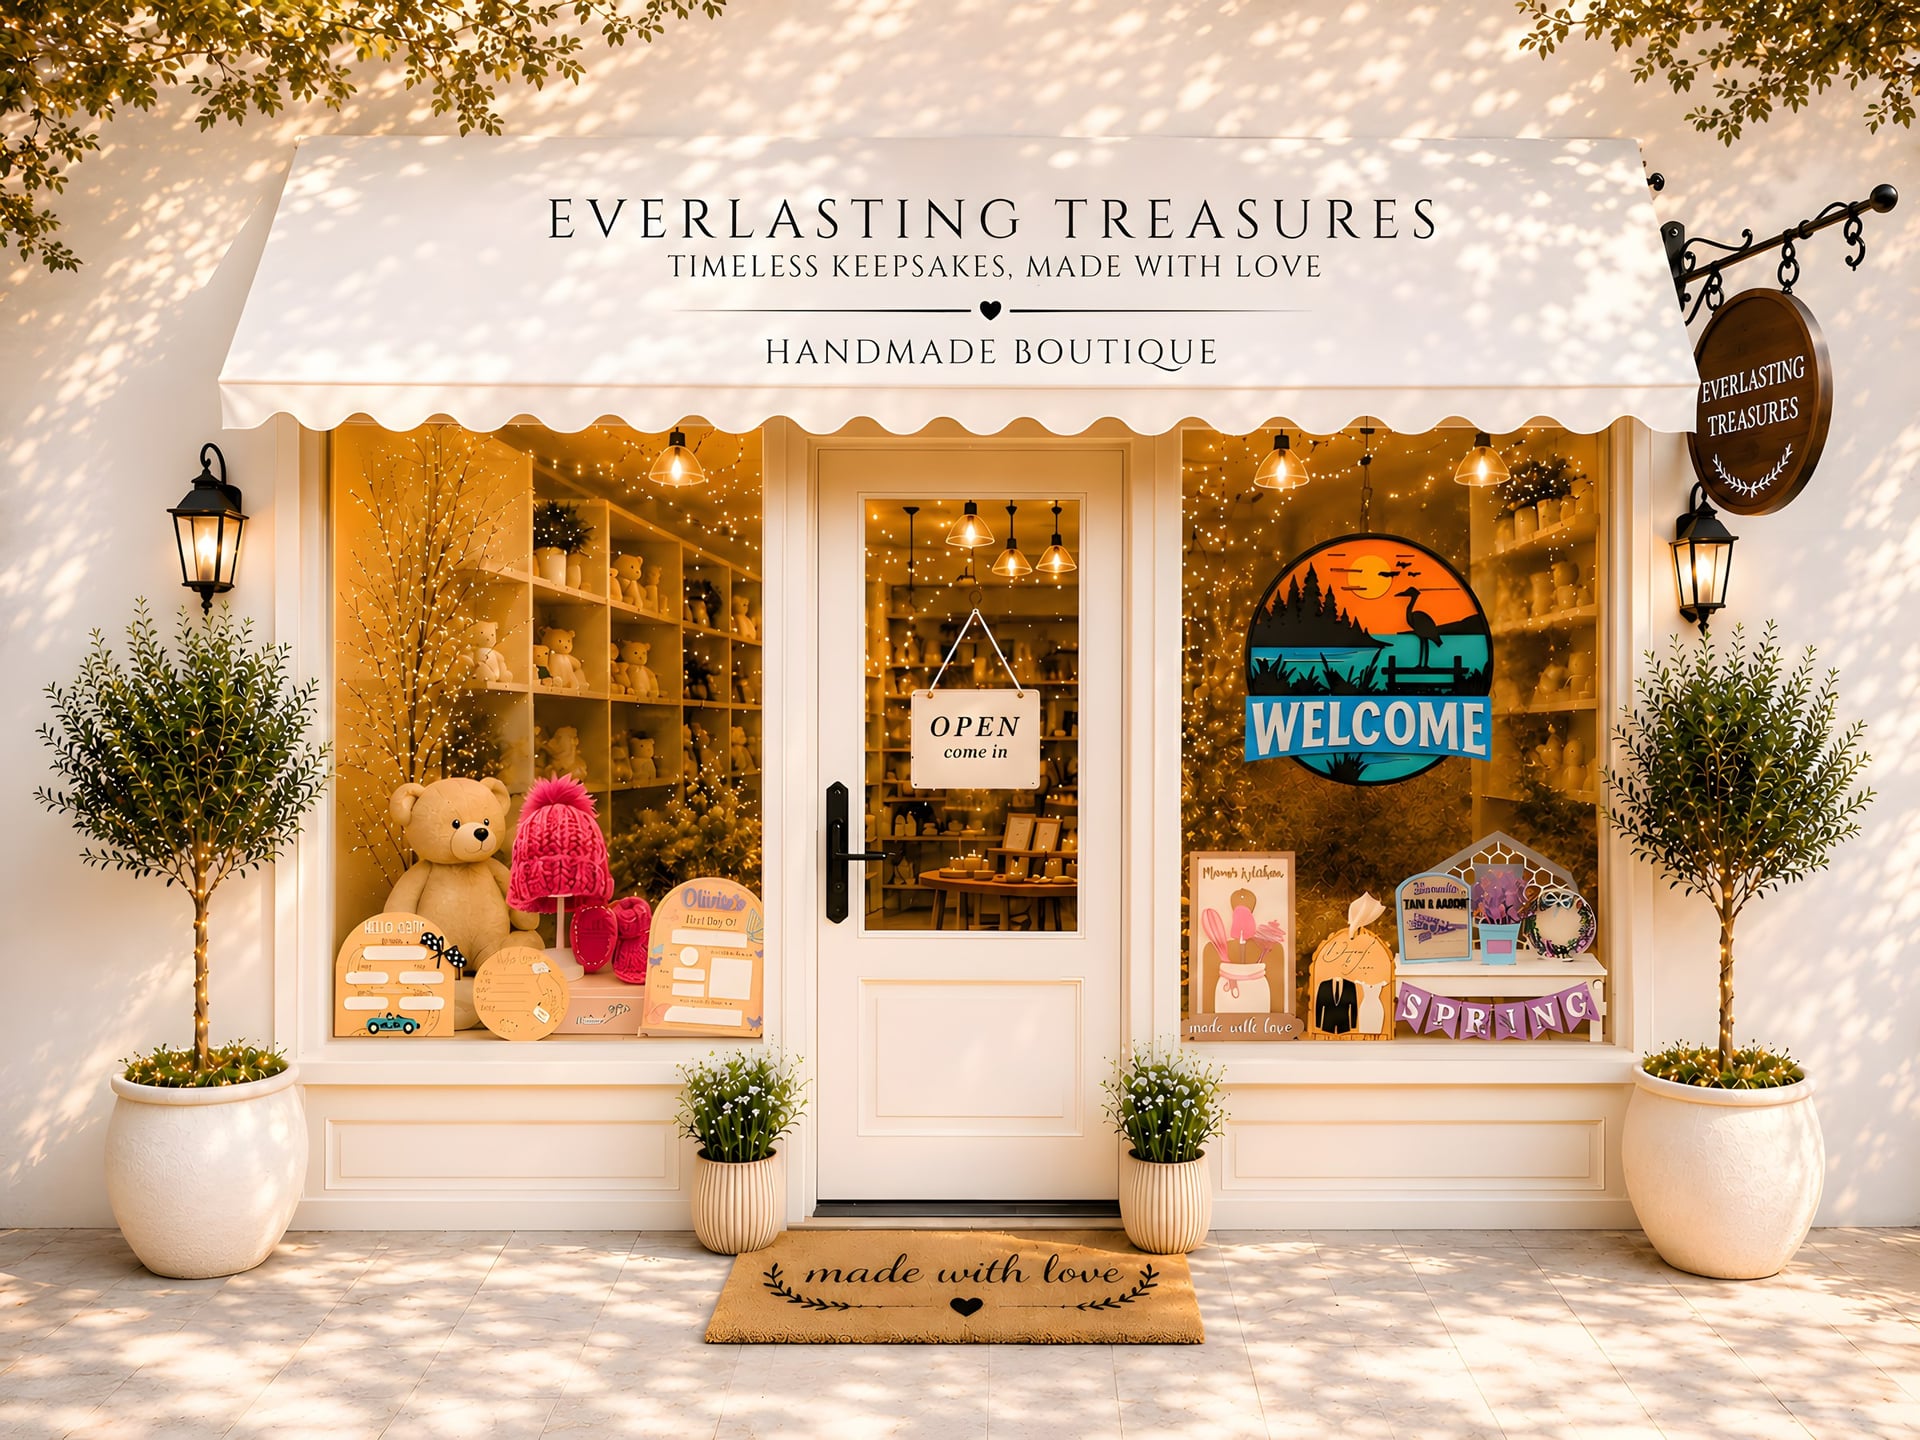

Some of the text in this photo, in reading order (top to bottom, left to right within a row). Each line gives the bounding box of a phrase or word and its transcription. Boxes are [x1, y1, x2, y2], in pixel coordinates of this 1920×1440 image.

[548, 198, 1435, 240] EVERLASTING TREASURES
[667, 254, 1321, 280] TIMELESS KEEPSAKES, MADE WITH LOVE
[767, 338, 1217, 372] HANDMADE BOUTIQUE
[1701, 355, 1805, 404] EVERLASTING
[1707, 396, 1800, 437] TREASURES
[930, 716, 1020, 737] OPEN
[1251, 700, 1487, 756] WELCOME
[943, 744, 1008, 759] come in
[1401, 990, 1589, 1035] SPRING
[805, 1252, 1125, 1284] made with love
